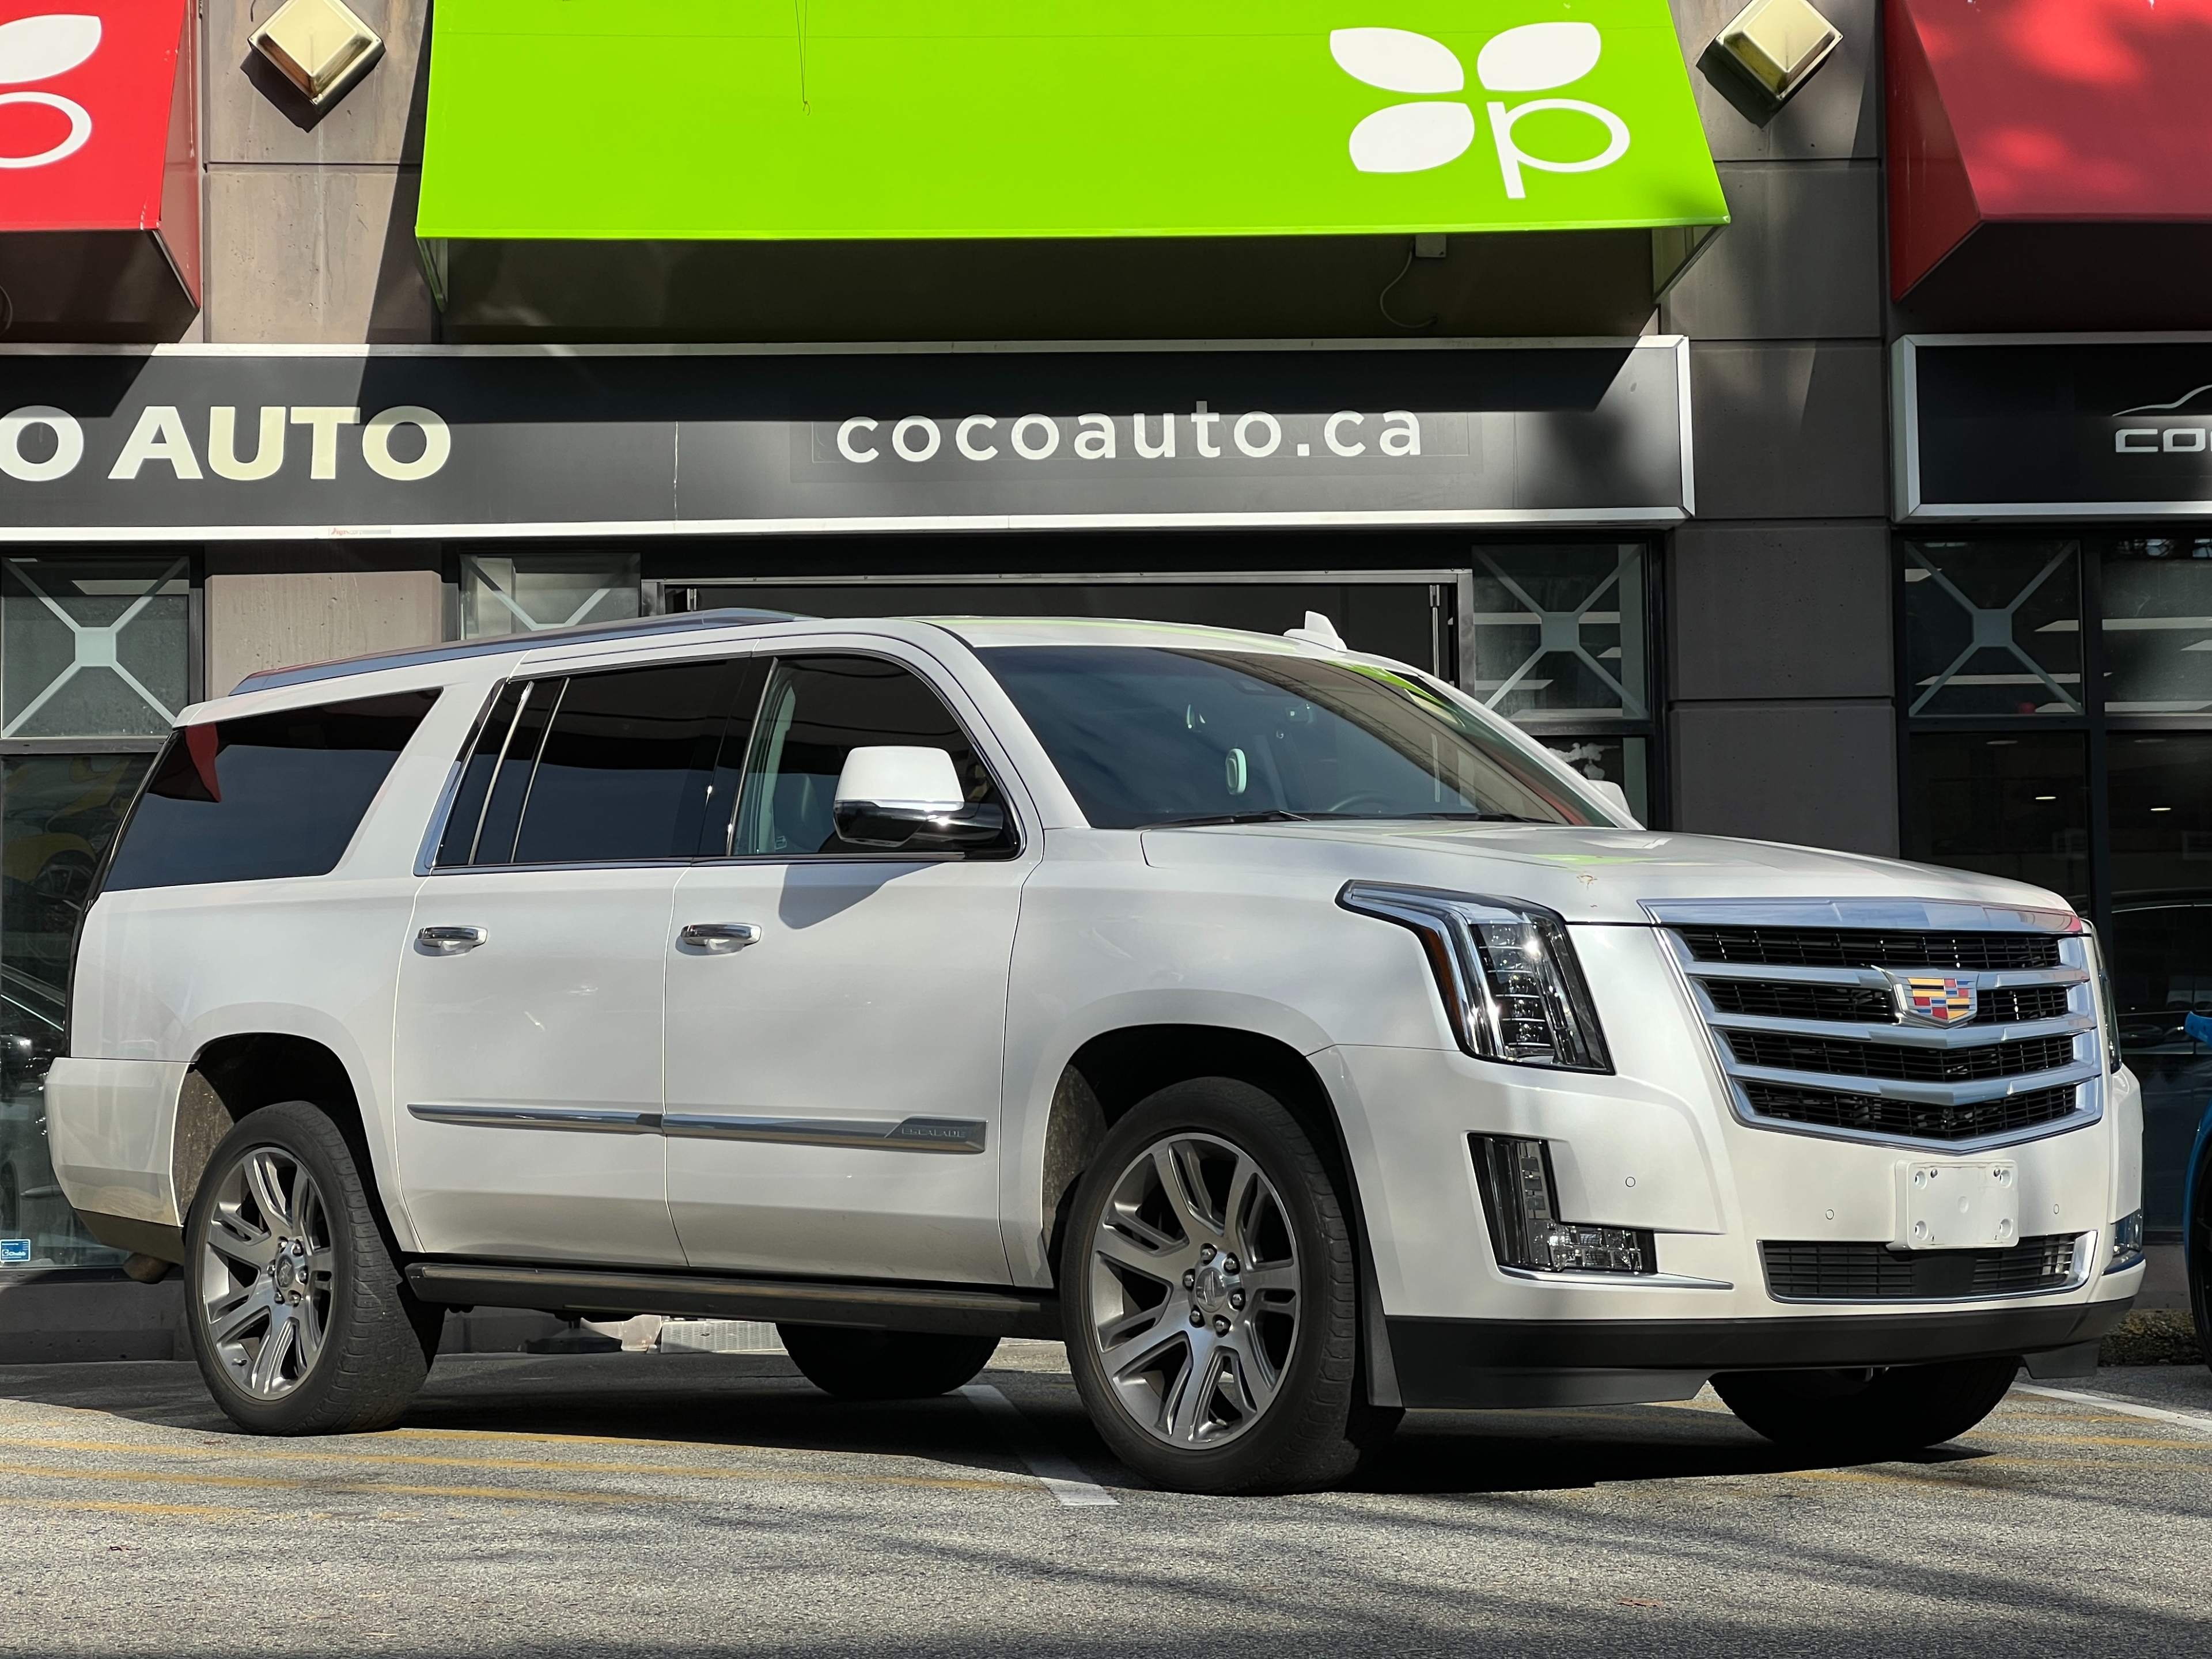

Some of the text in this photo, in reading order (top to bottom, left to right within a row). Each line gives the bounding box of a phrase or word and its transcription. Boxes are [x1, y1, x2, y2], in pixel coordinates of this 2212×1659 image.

[107, 406, 452, 482] AUTO
[836, 400, 1422, 463] cocoauto.ca
[2115, 427, 2212, 453] CO
[901, 1127, 967, 1138] ESCALADE
